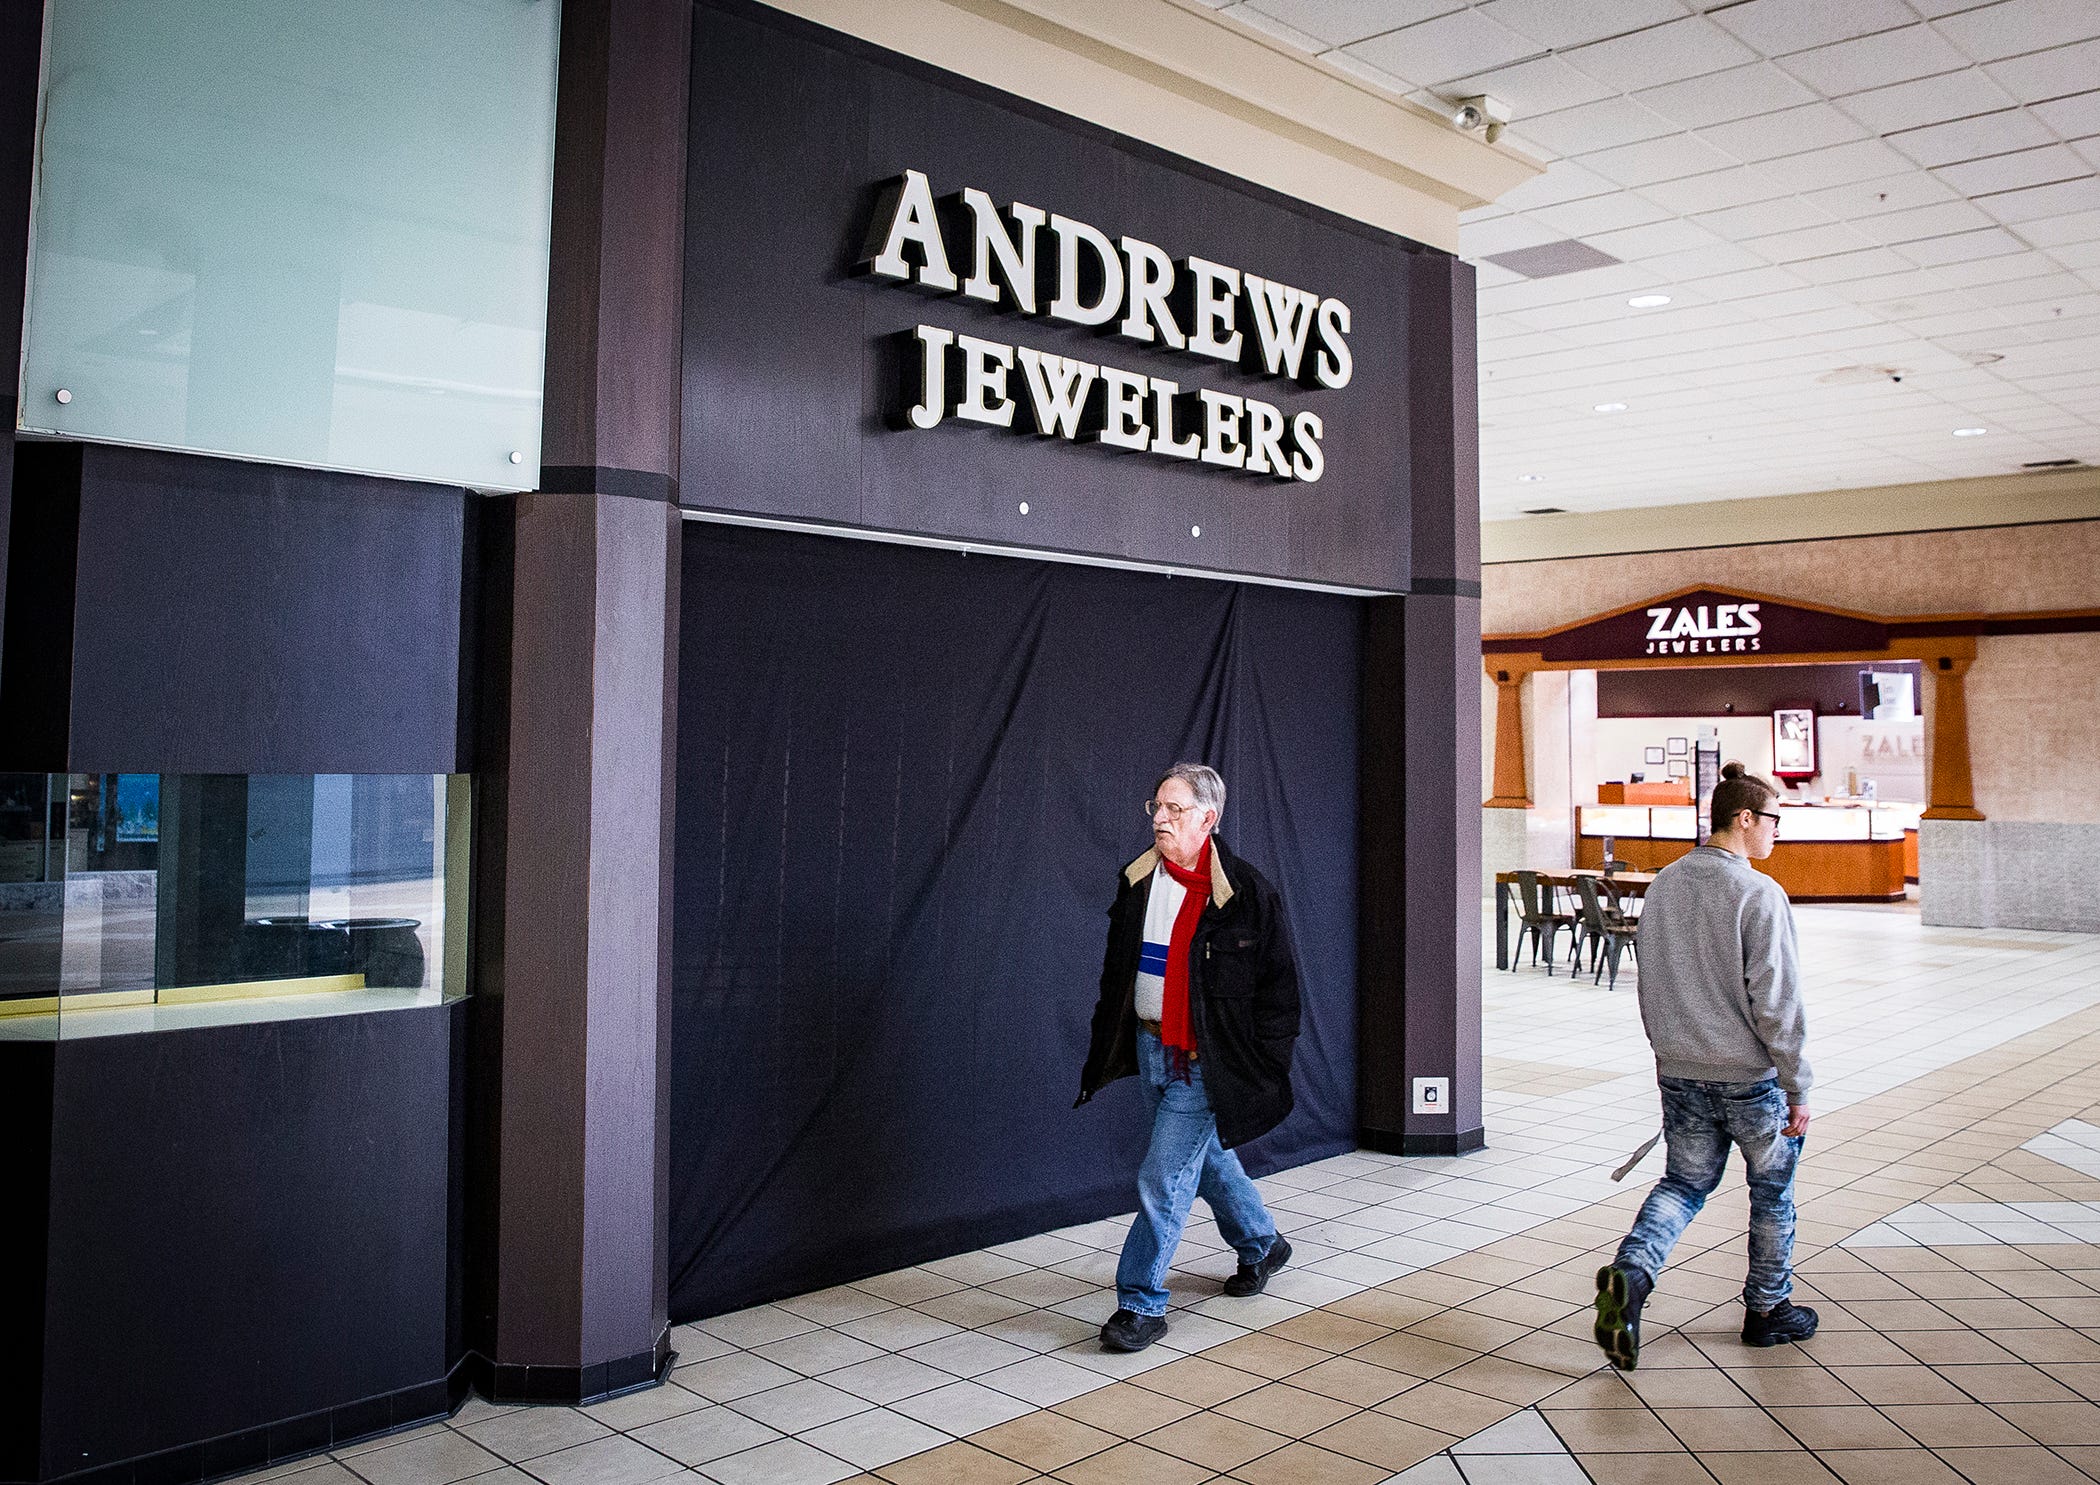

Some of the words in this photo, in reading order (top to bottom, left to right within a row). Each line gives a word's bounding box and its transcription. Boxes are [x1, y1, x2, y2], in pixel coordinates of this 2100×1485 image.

[874, 168, 1353, 390] ANDREWS
[910, 324, 1325, 483] JEWELERS
[1645, 603, 1762, 640] ZALES
[1645, 637, 1761, 655] JEWELERS
